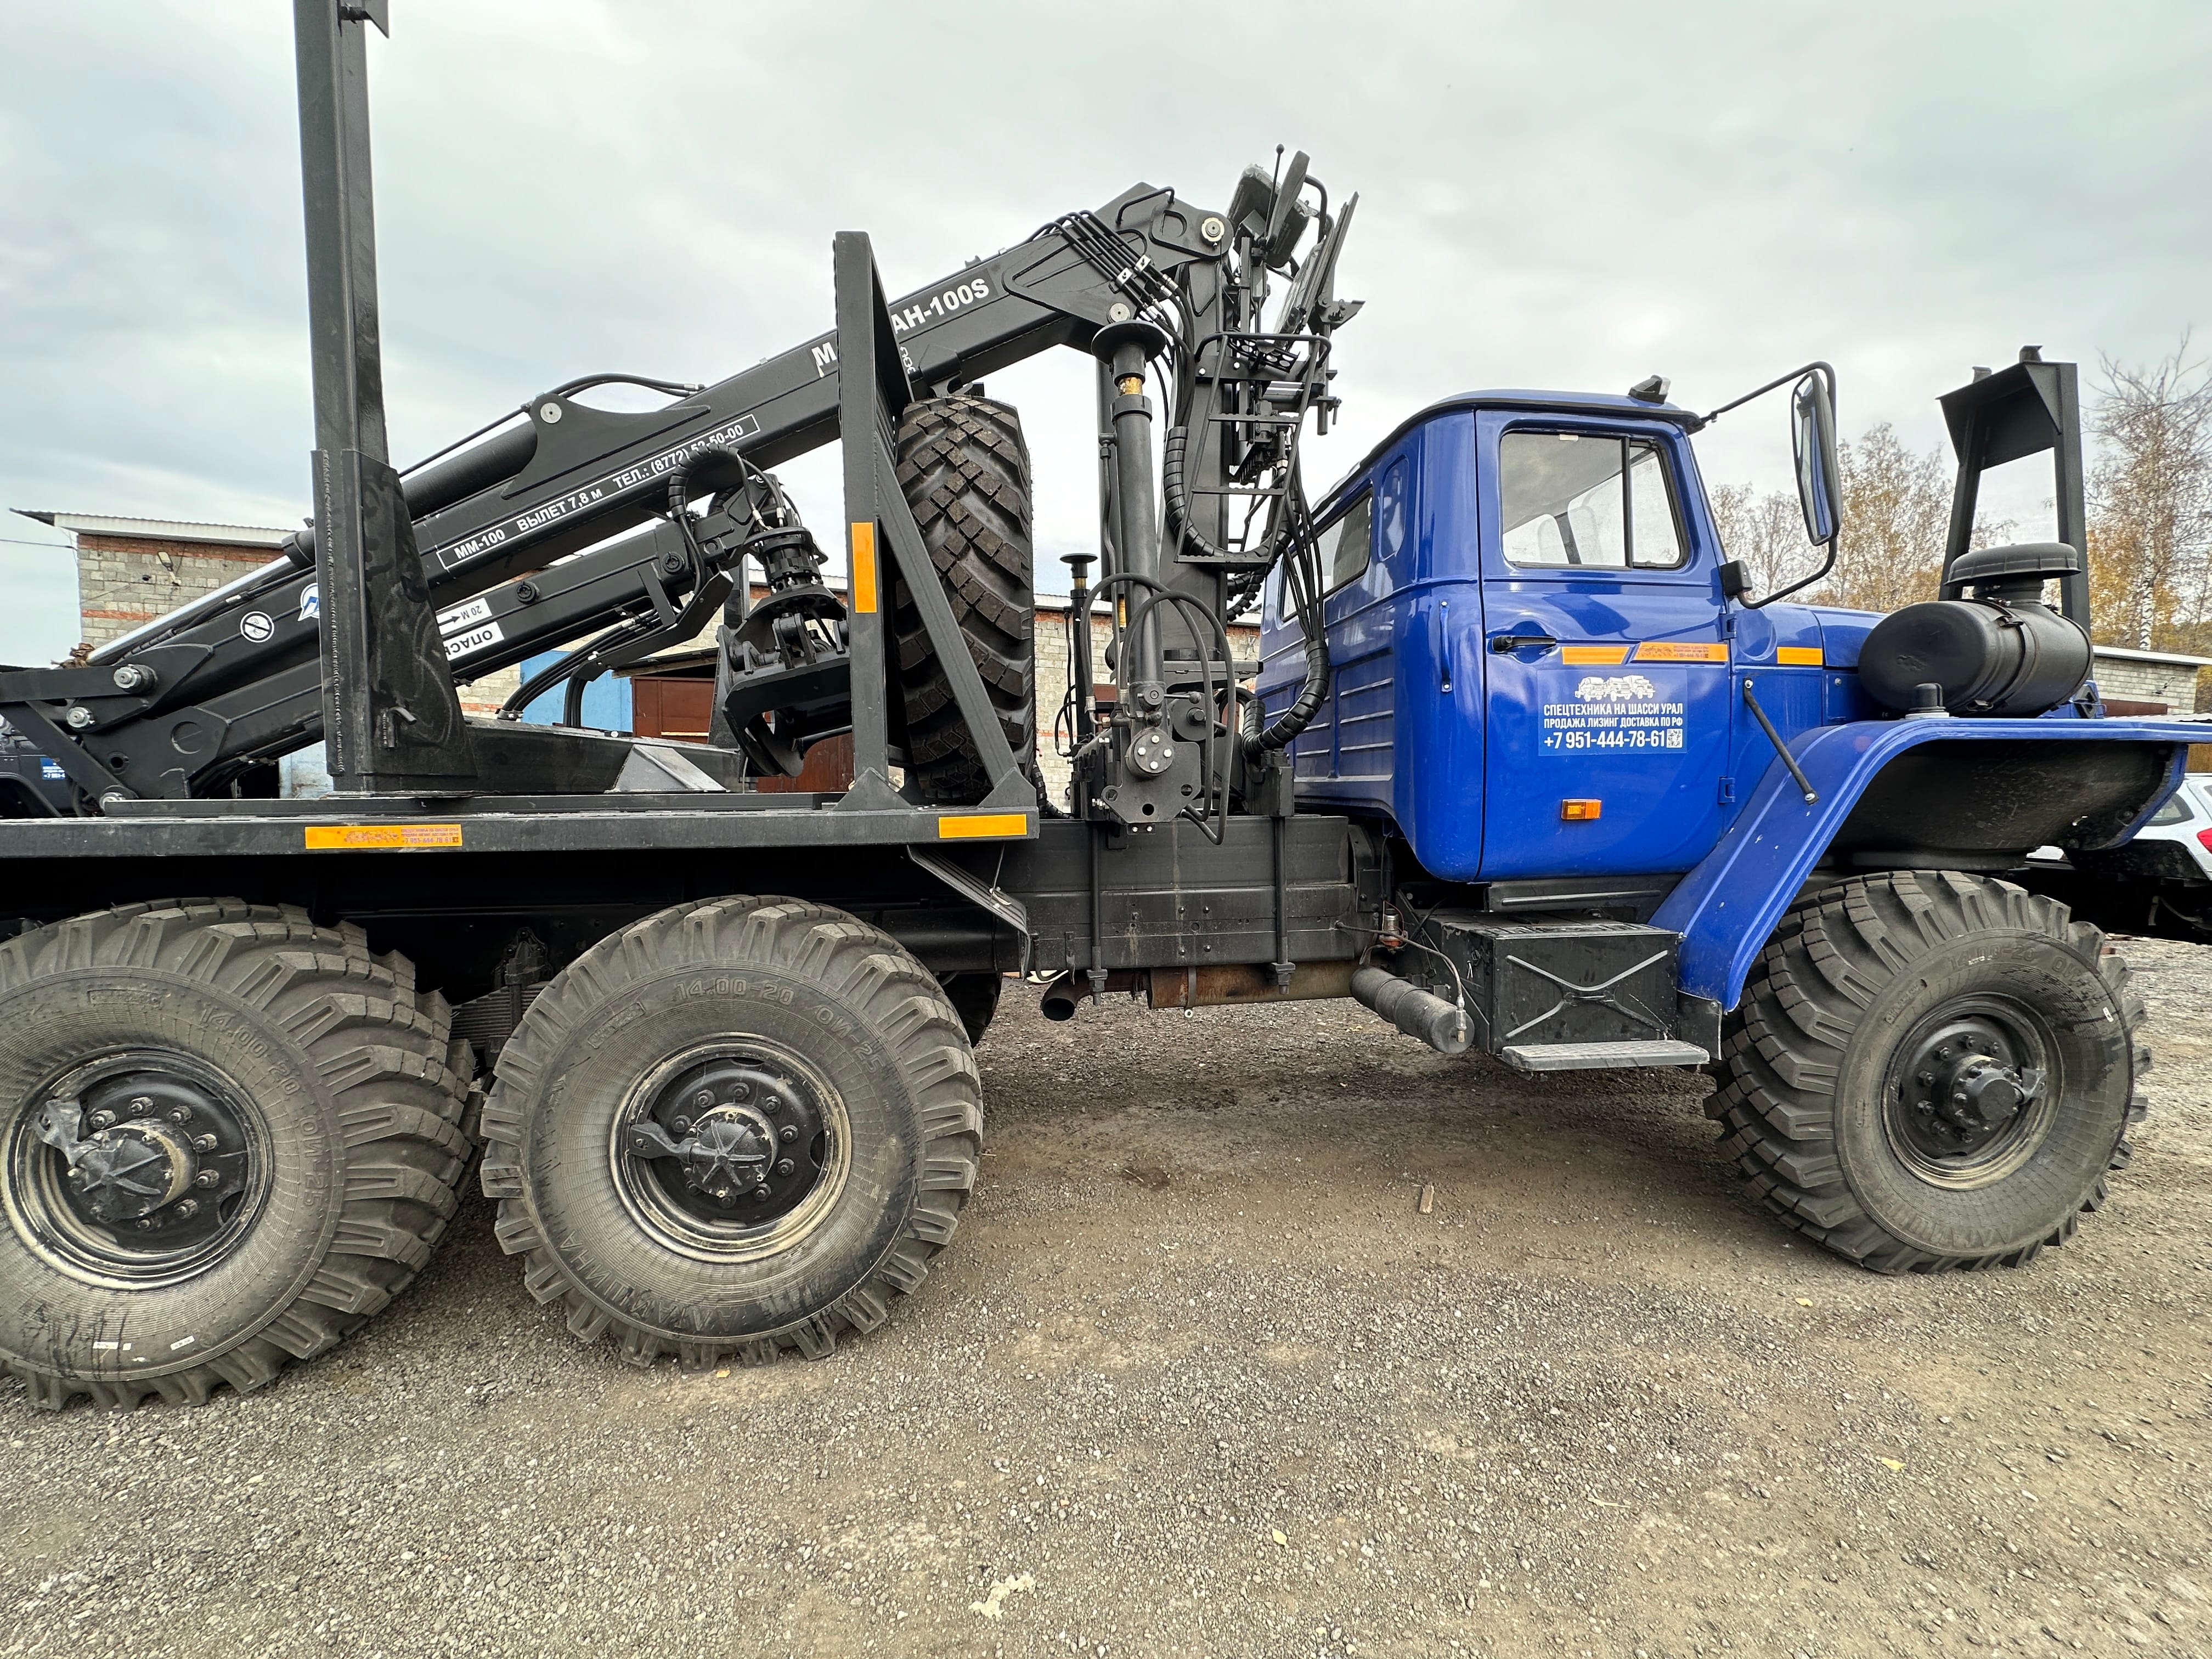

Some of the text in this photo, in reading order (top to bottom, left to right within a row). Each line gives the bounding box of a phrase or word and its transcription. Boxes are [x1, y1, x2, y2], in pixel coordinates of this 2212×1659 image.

[811, 278, 989, 366] МАН-100S
[454, 529, 505, 559] ММ-100
[516, 501, 567, 531] ВЫЛЕТ
[567, 492, 589, 508] 7,8
[612, 467, 650, 488] ТЕЛ.:
[471, 605, 482, 616] 20
[1544, 703, 1683, 716] СПЕЦТЕХНИКА НА ШАССИ УРАЛ
[1544, 716, 1683, 729] ПРОДАЖА ЛИЗИНГ ДОСТАВКА ПО РФ
[1544, 730, 1665, 749] +7 951-444-78-61
[676, 977, 794, 1006] 14.00-20
